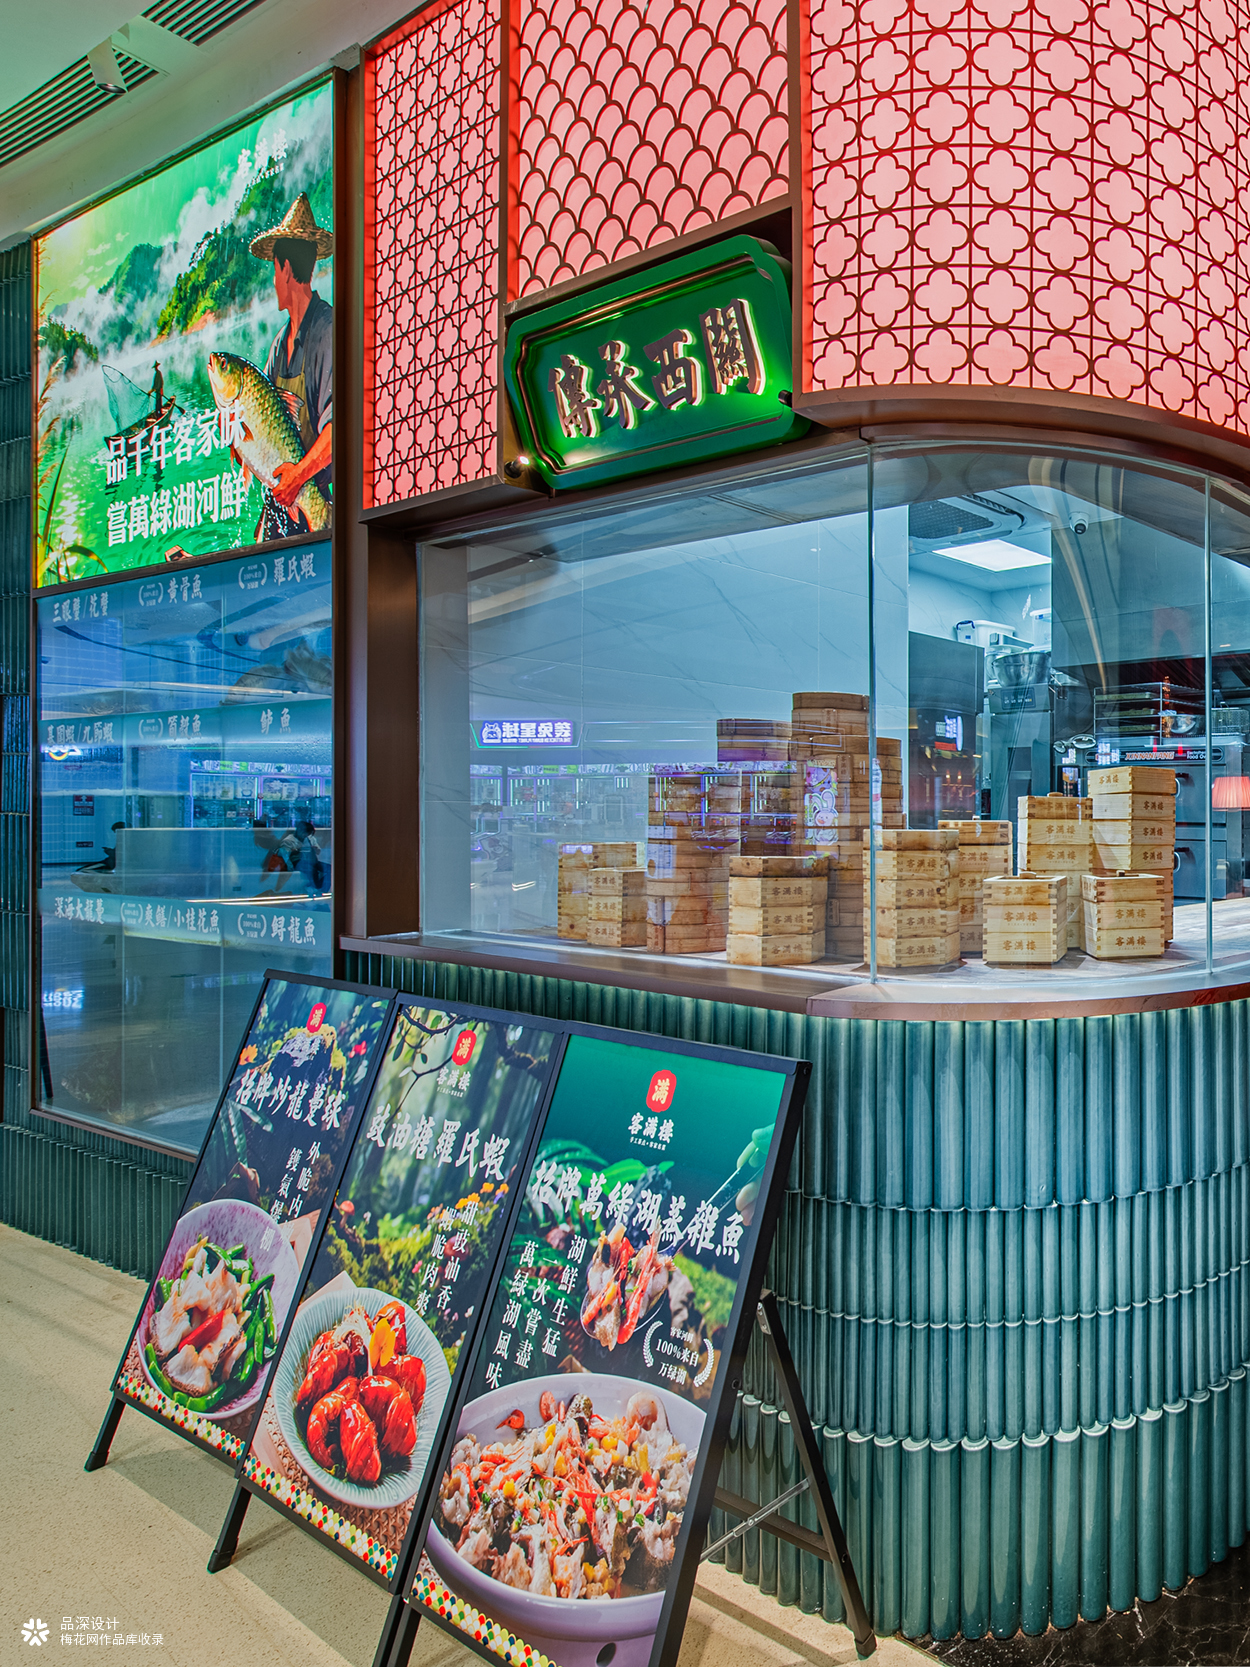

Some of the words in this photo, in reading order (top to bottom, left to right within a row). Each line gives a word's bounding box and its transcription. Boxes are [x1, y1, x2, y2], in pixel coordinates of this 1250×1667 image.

[106, 400, 246, 485] 品千年客家味
[273, 553, 317, 586] 羅氏蝦
[1143, 800, 1164, 811] 客满楼
[1046, 825, 1076, 834] 客满楼
[1143, 827, 1163, 836] 客满楼
[1046, 851, 1076, 860] 客满楼
[1143, 851, 1163, 861] 客满楼
[907, 859, 937, 868] 客满楼
[771, 886, 804, 896] 客满楼
[773, 914, 804, 924] 客满楼
[1004, 911, 1039, 922] 客满楼
[1115, 908, 1147, 919] 客满楼
[906, 916, 937, 926] 客满楼
[1002, 940, 1037, 951] 客满楼
[1115, 936, 1147, 947] 客满楼
[771, 943, 804, 955] 客满楼
[906, 945, 937, 955] 客满楼
[436, 1066, 472, 1092] 客满楼
[652, 1078, 670, 1105] 满
[627, 1112, 675, 1144] 客满楼
[366, 1103, 511, 1181] 豉油糖羅氏蝦
[436, 1201, 479, 1310] 甜豉油香
[541, 1234, 588, 1357] 湖鮮生猛
[514, 1257, 559, 1369] 一次嘗盡
[655, 1338, 700, 1367] 100%来自
[658, 1361, 688, 1386] 万绿湖
